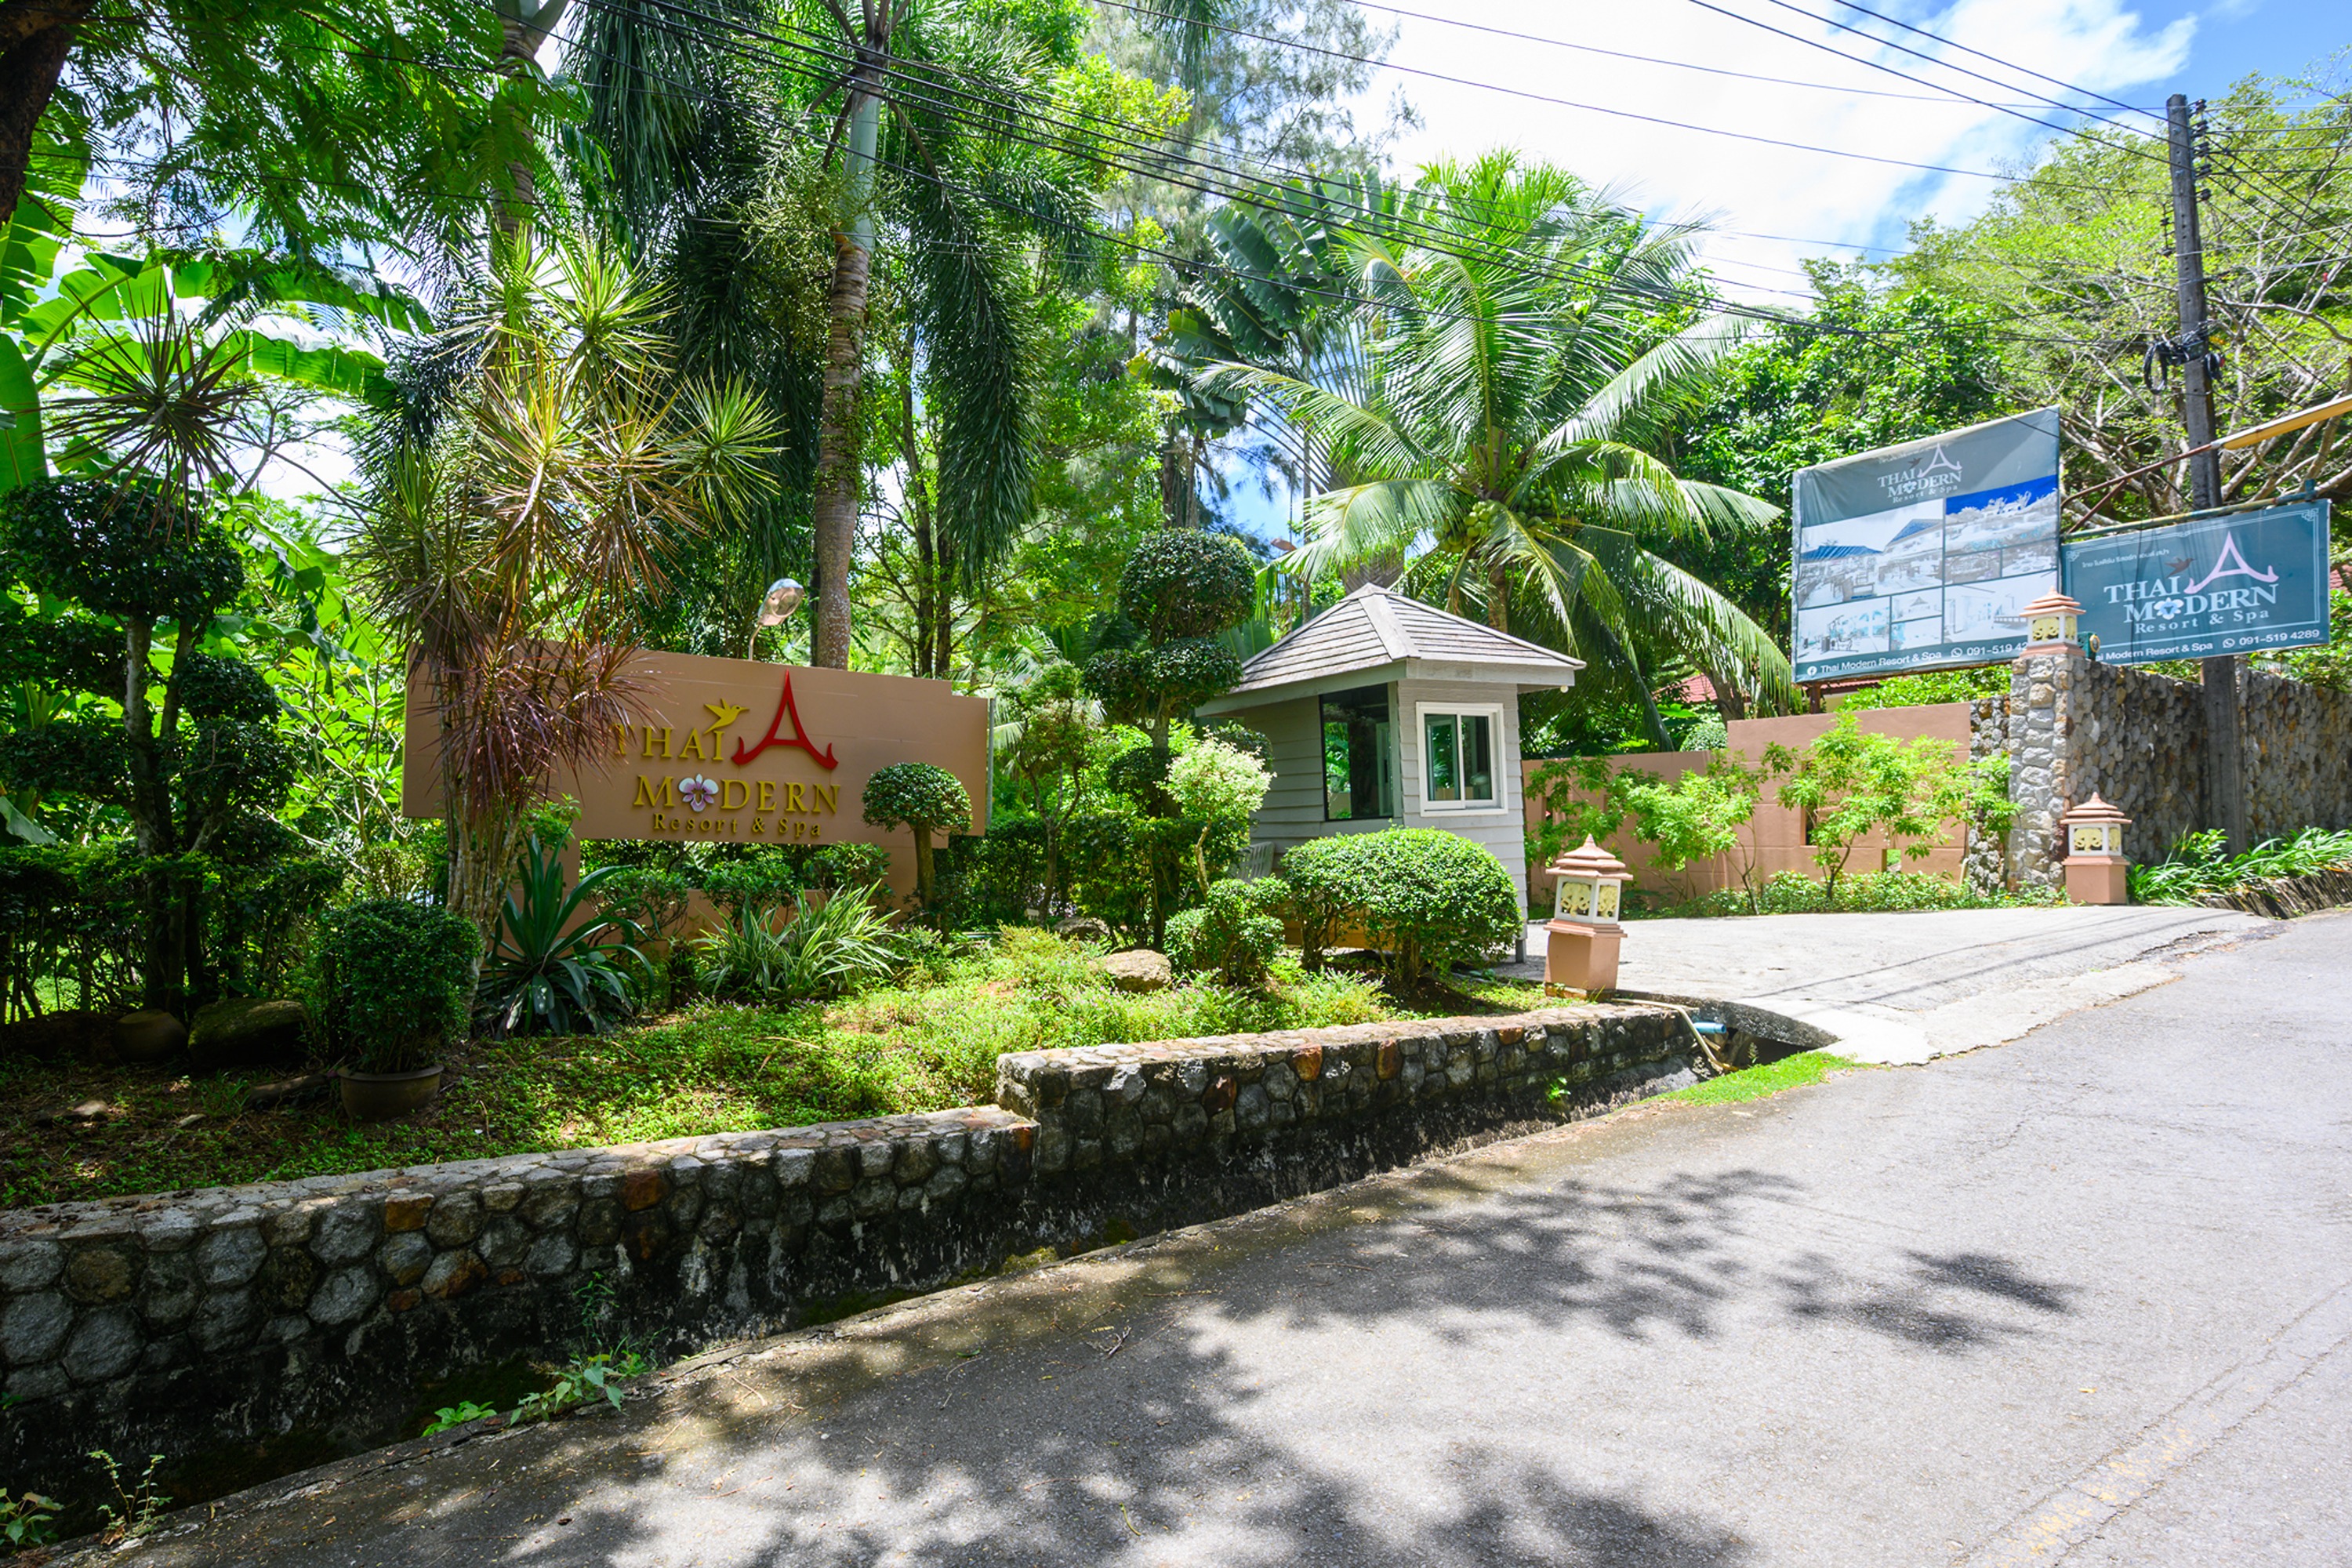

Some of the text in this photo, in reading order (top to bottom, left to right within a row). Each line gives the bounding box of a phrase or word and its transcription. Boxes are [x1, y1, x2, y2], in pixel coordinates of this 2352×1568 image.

[1877, 468, 1915, 488] THAI
[1893, 491, 1924, 503] Resort
[1940, 485, 1958, 494] Spa
[2103, 575, 2181, 604] THAI
[2135, 608, 2270, 634] Resort & Spa
[1820, 664, 1840, 674] Thai
[1842, 660, 1877, 673] Modern
[1878, 655, 1911, 666] Resort
[1911, 654, 1920, 662] &
[1922, 650, 1942, 662] Spa
[1966, 642, 2013, 657] 091-519
[2106, 649, 2143, 660] Modern
[2145, 645, 2180, 657] Resort
[2181, 644, 2190, 652] &
[2191, 641, 2213, 653] Spa
[2239, 632, 2288, 646] 091-519
[2290, 630, 2320, 641] 4289
[653, 812, 821, 838] Resort & Spa
